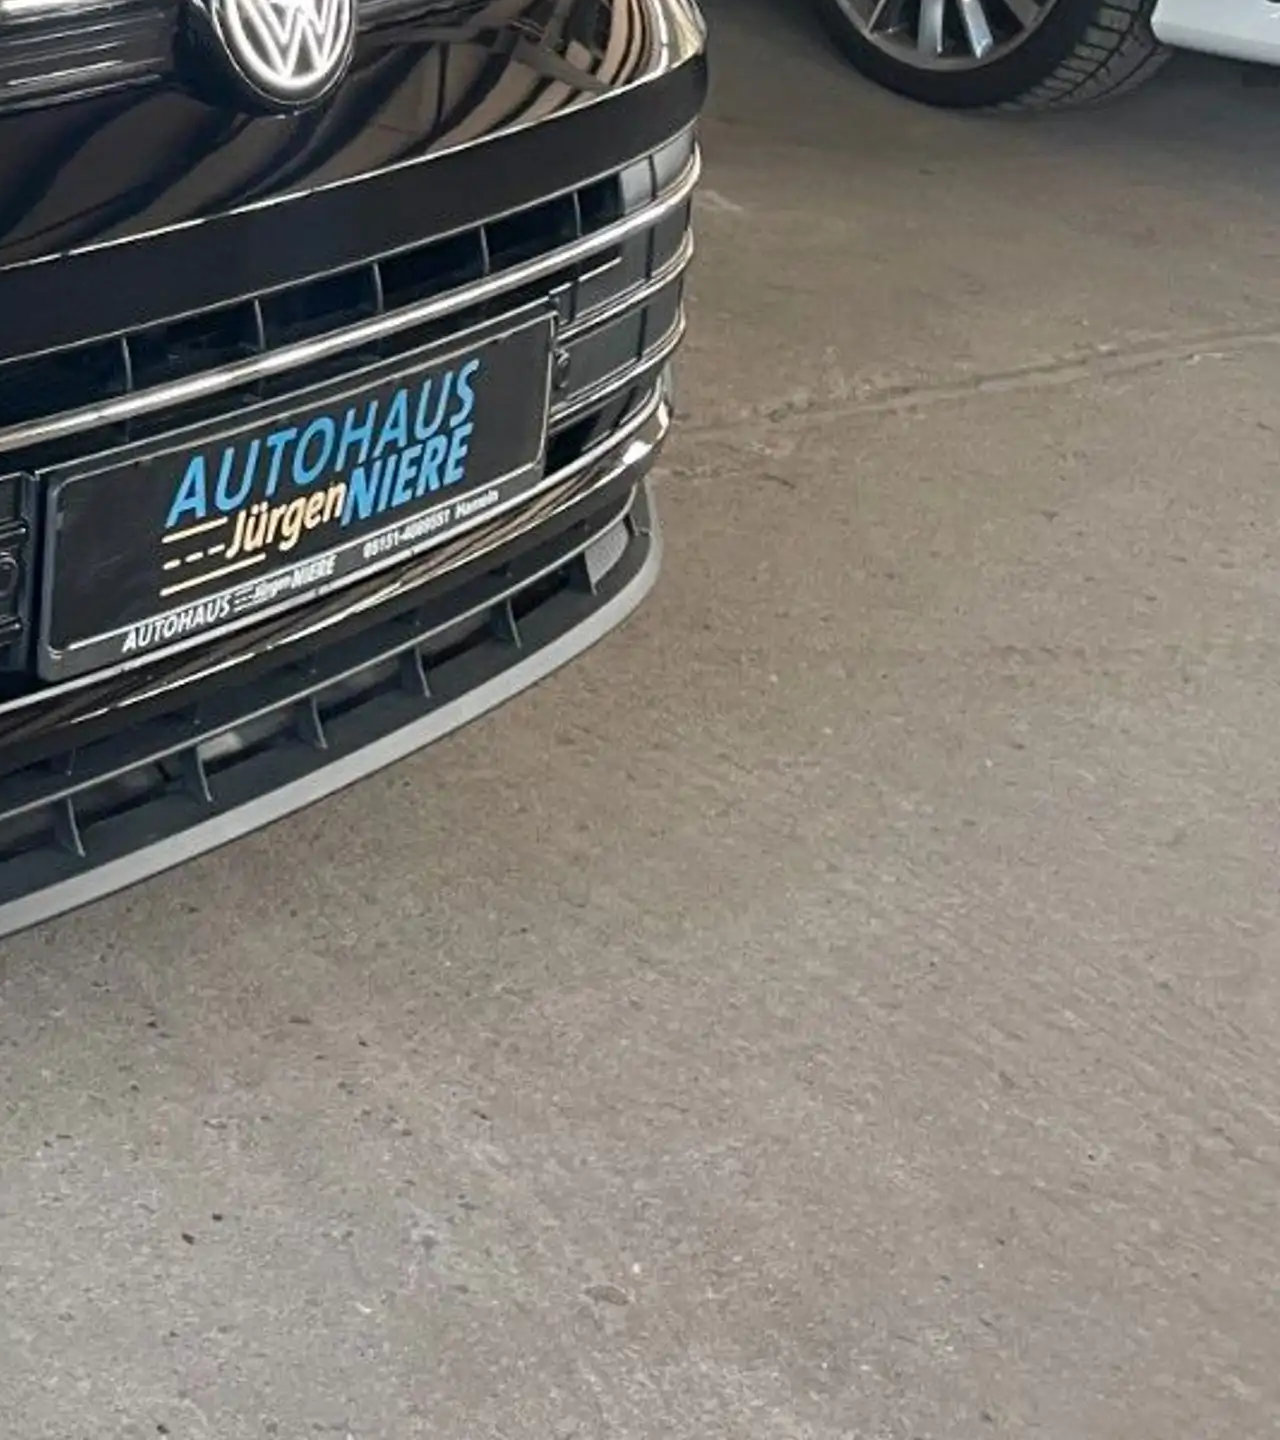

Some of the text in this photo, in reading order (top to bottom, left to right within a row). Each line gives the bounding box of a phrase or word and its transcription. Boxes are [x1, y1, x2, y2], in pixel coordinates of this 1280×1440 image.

[164, 358, 480, 529] AUTOHAUS
[225, 422, 474, 559] Jürgen NIERE
[121, 595, 232, 653] AUTOHAUS
